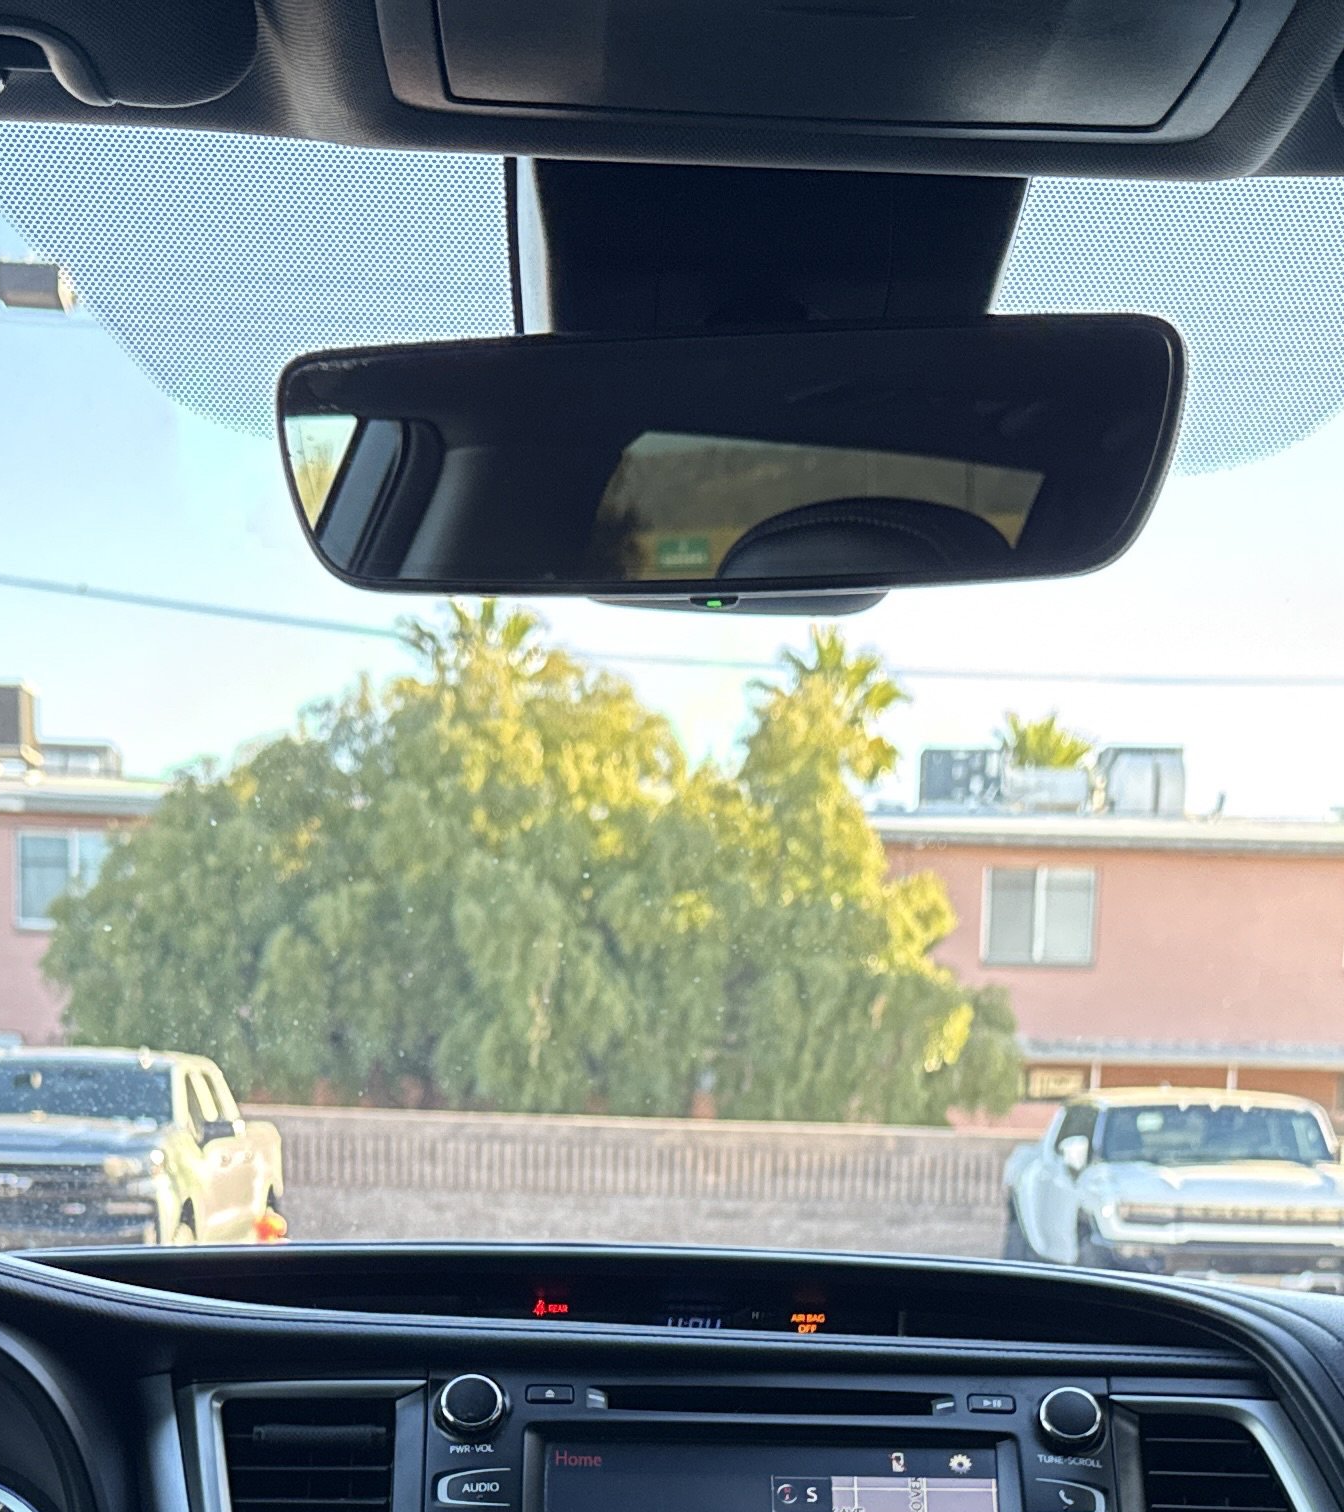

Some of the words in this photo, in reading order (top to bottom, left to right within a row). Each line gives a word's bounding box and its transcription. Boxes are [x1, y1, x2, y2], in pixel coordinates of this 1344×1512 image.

[555, 1451, 603, 1468] Home
[461, 1481, 500, 1493] AUDIO
[806, 1487, 818, 1503] S
